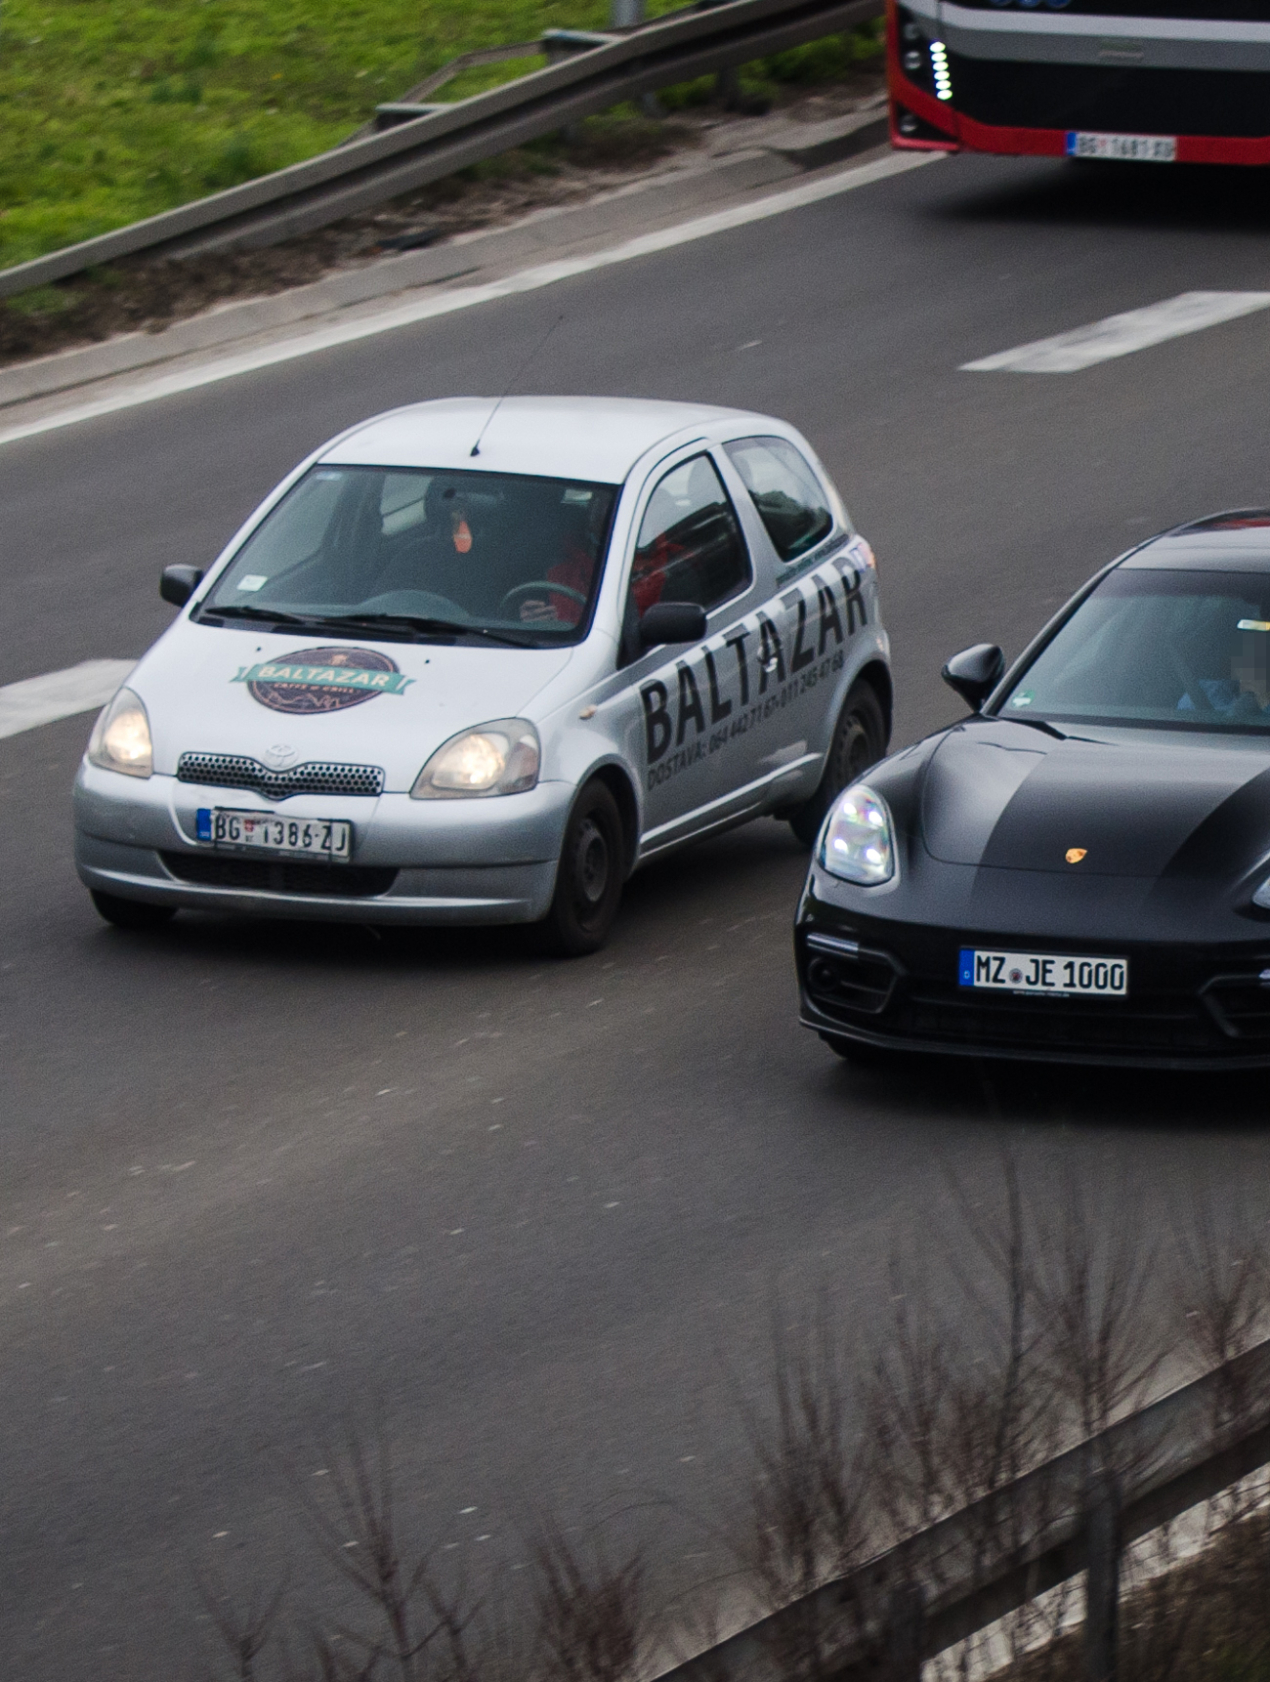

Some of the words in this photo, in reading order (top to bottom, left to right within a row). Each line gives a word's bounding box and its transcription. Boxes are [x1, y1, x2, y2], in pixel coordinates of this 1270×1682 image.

[257, 666, 389, 687] BALTAZAR
[639, 556, 867, 766] BALTAZAR
[215, 814, 241, 840] BG
[976, 955, 1006, 984] MZ
[1025, 958, 1056, 987] JE
[1063, 960, 1124, 991] 1000
